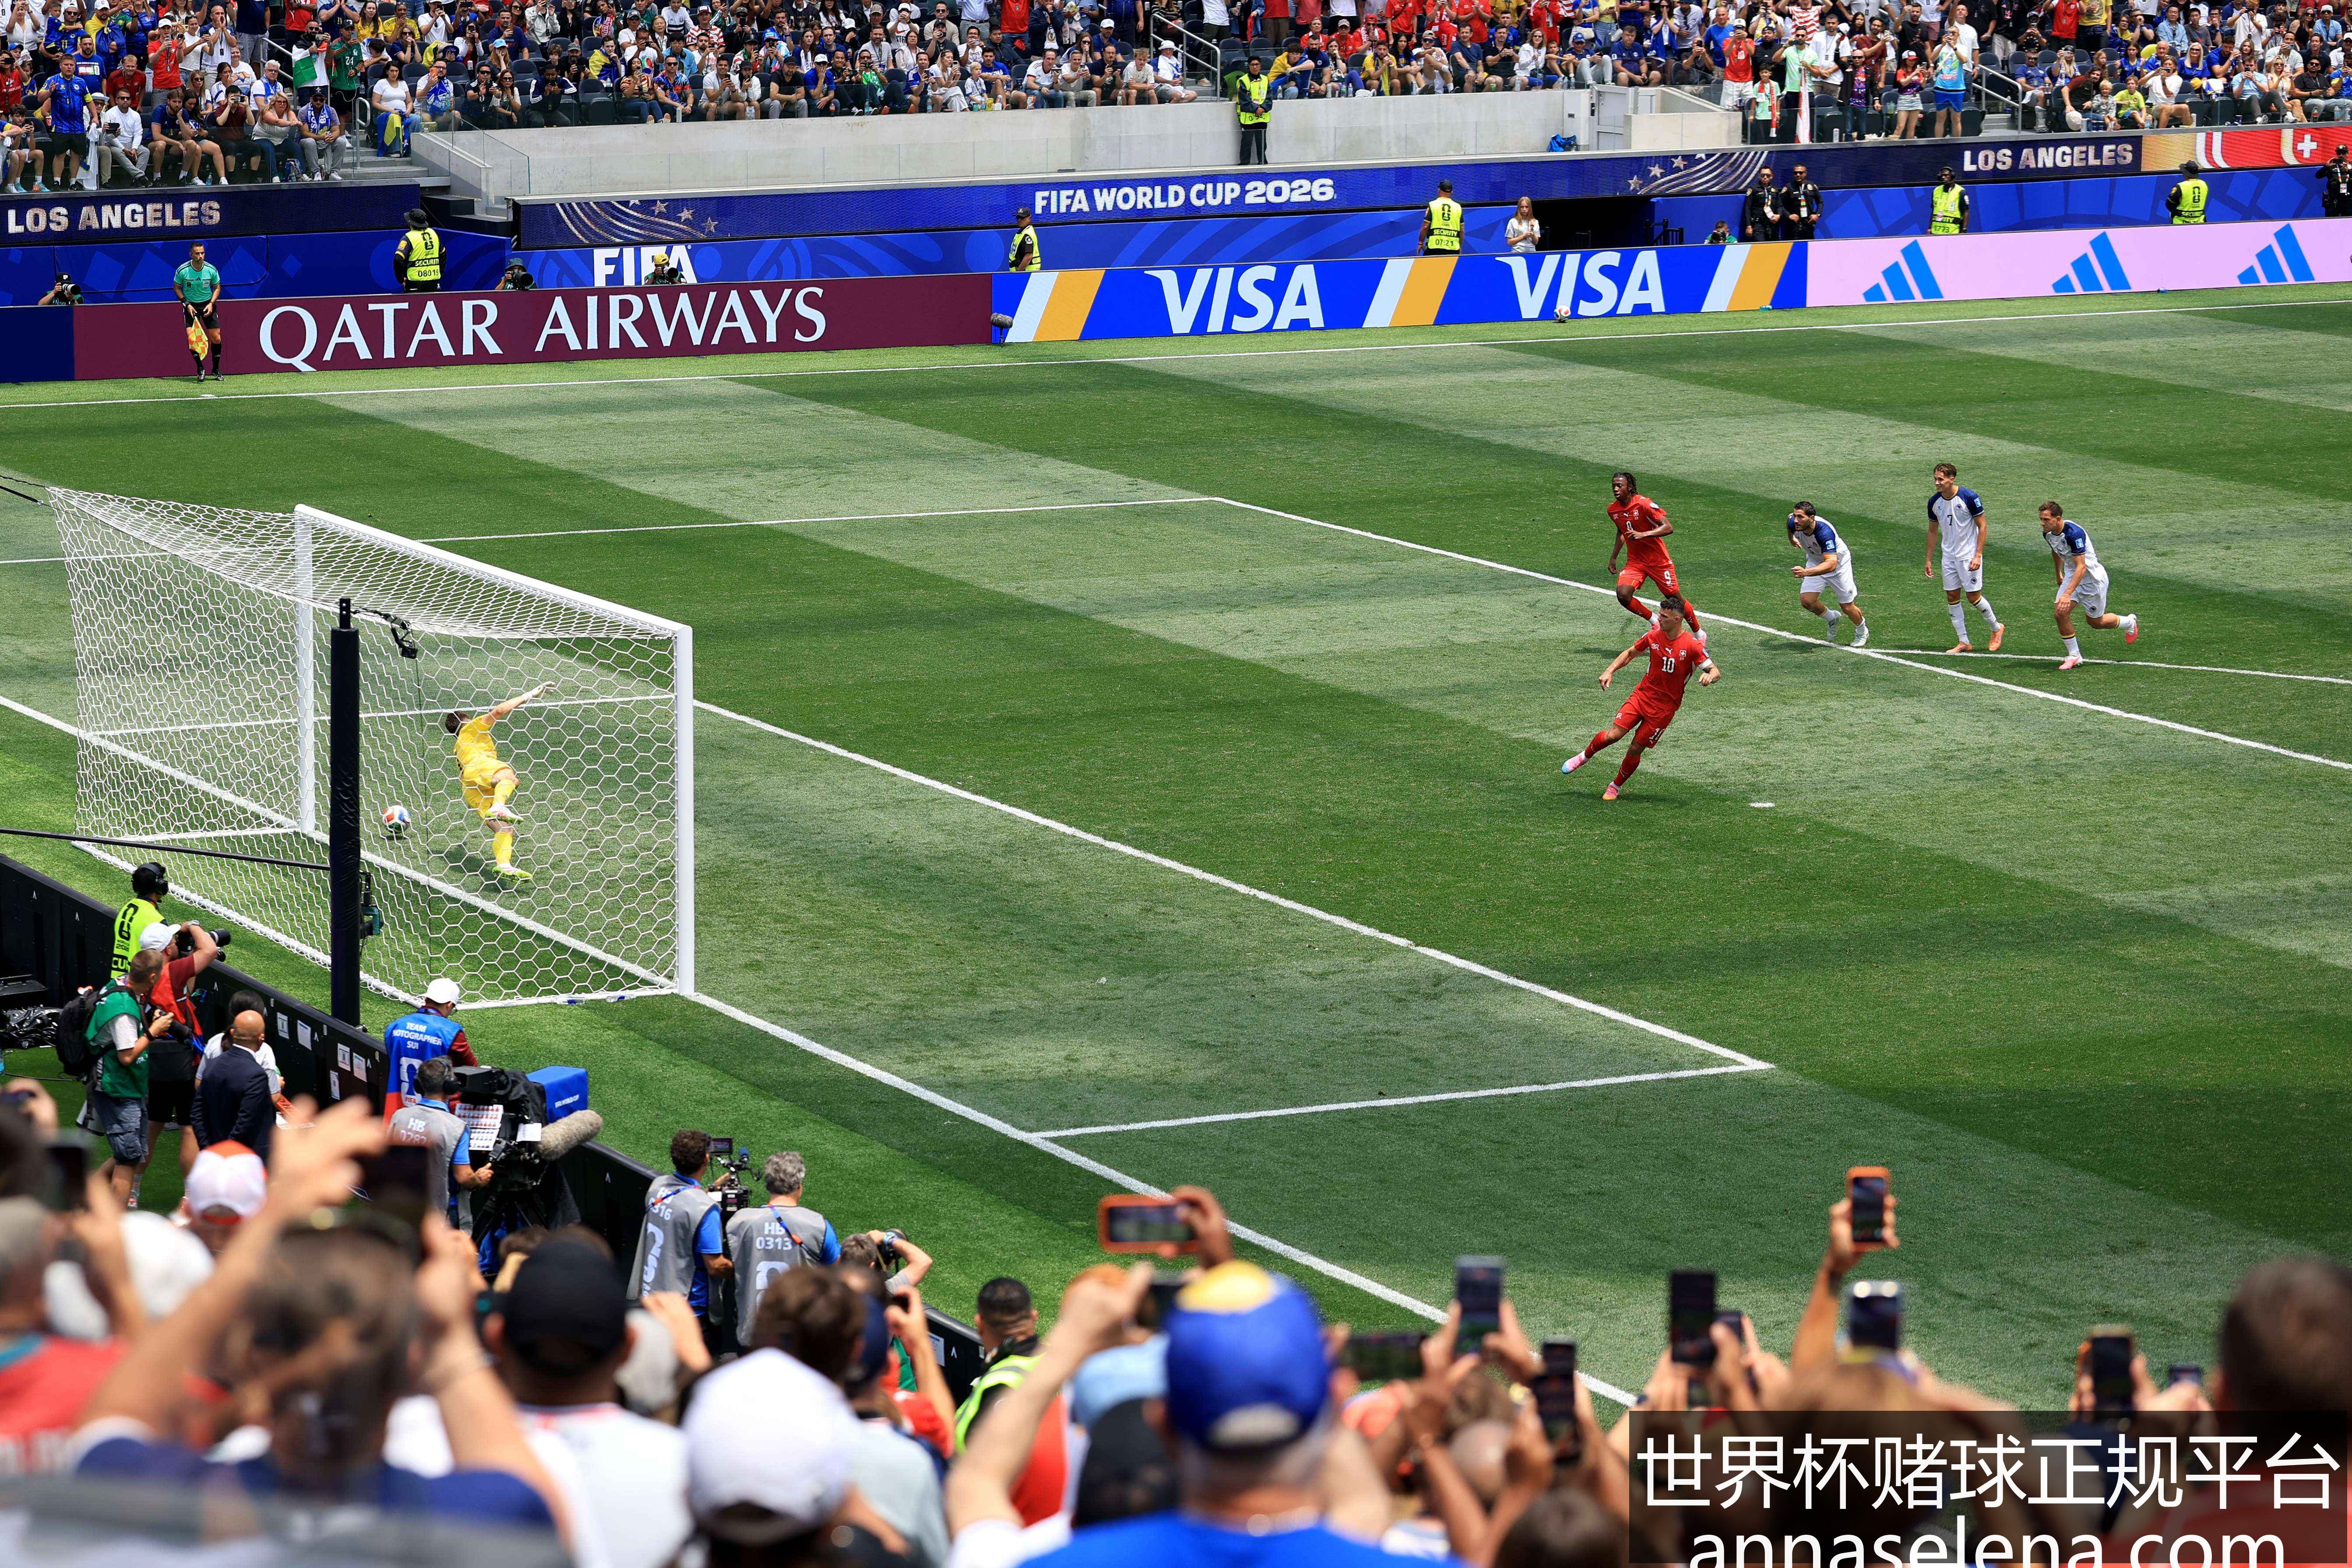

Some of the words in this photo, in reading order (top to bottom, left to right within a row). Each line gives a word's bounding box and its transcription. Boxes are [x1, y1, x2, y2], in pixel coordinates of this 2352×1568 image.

[1963, 148, 2012, 171] LOS
[2019, 144, 2133, 169] ANGELES
[1034, 189, 1090, 214] FIFA
[1093, 184, 1186, 211] WORLD
[1189, 182, 1241, 206] CUP
[1244, 178, 1334, 204] 2026
[7, 207, 68, 233] LOS
[78, 201, 221, 229] ANGELES
[594, 245, 697, 287] FIFA
[1495, 250, 1665, 319] VISA
[1144, 264, 1324, 334] VISA
[259, 299, 503, 372] QATAR
[534, 286, 826, 352] AIRWAYS
[1947, 514, 1953, 526] 7
[1664, 570, 1672, 585] 9
[1662, 656, 1675, 673] 10
[406, 1022, 427, 1033] TEAM
[392, 1029, 442, 1046] HOTOGRAPHER
[406, 1040, 419, 1050] SUI
[407, 1117, 426, 1132] HB
[756, 1237, 792, 1250] 0313
